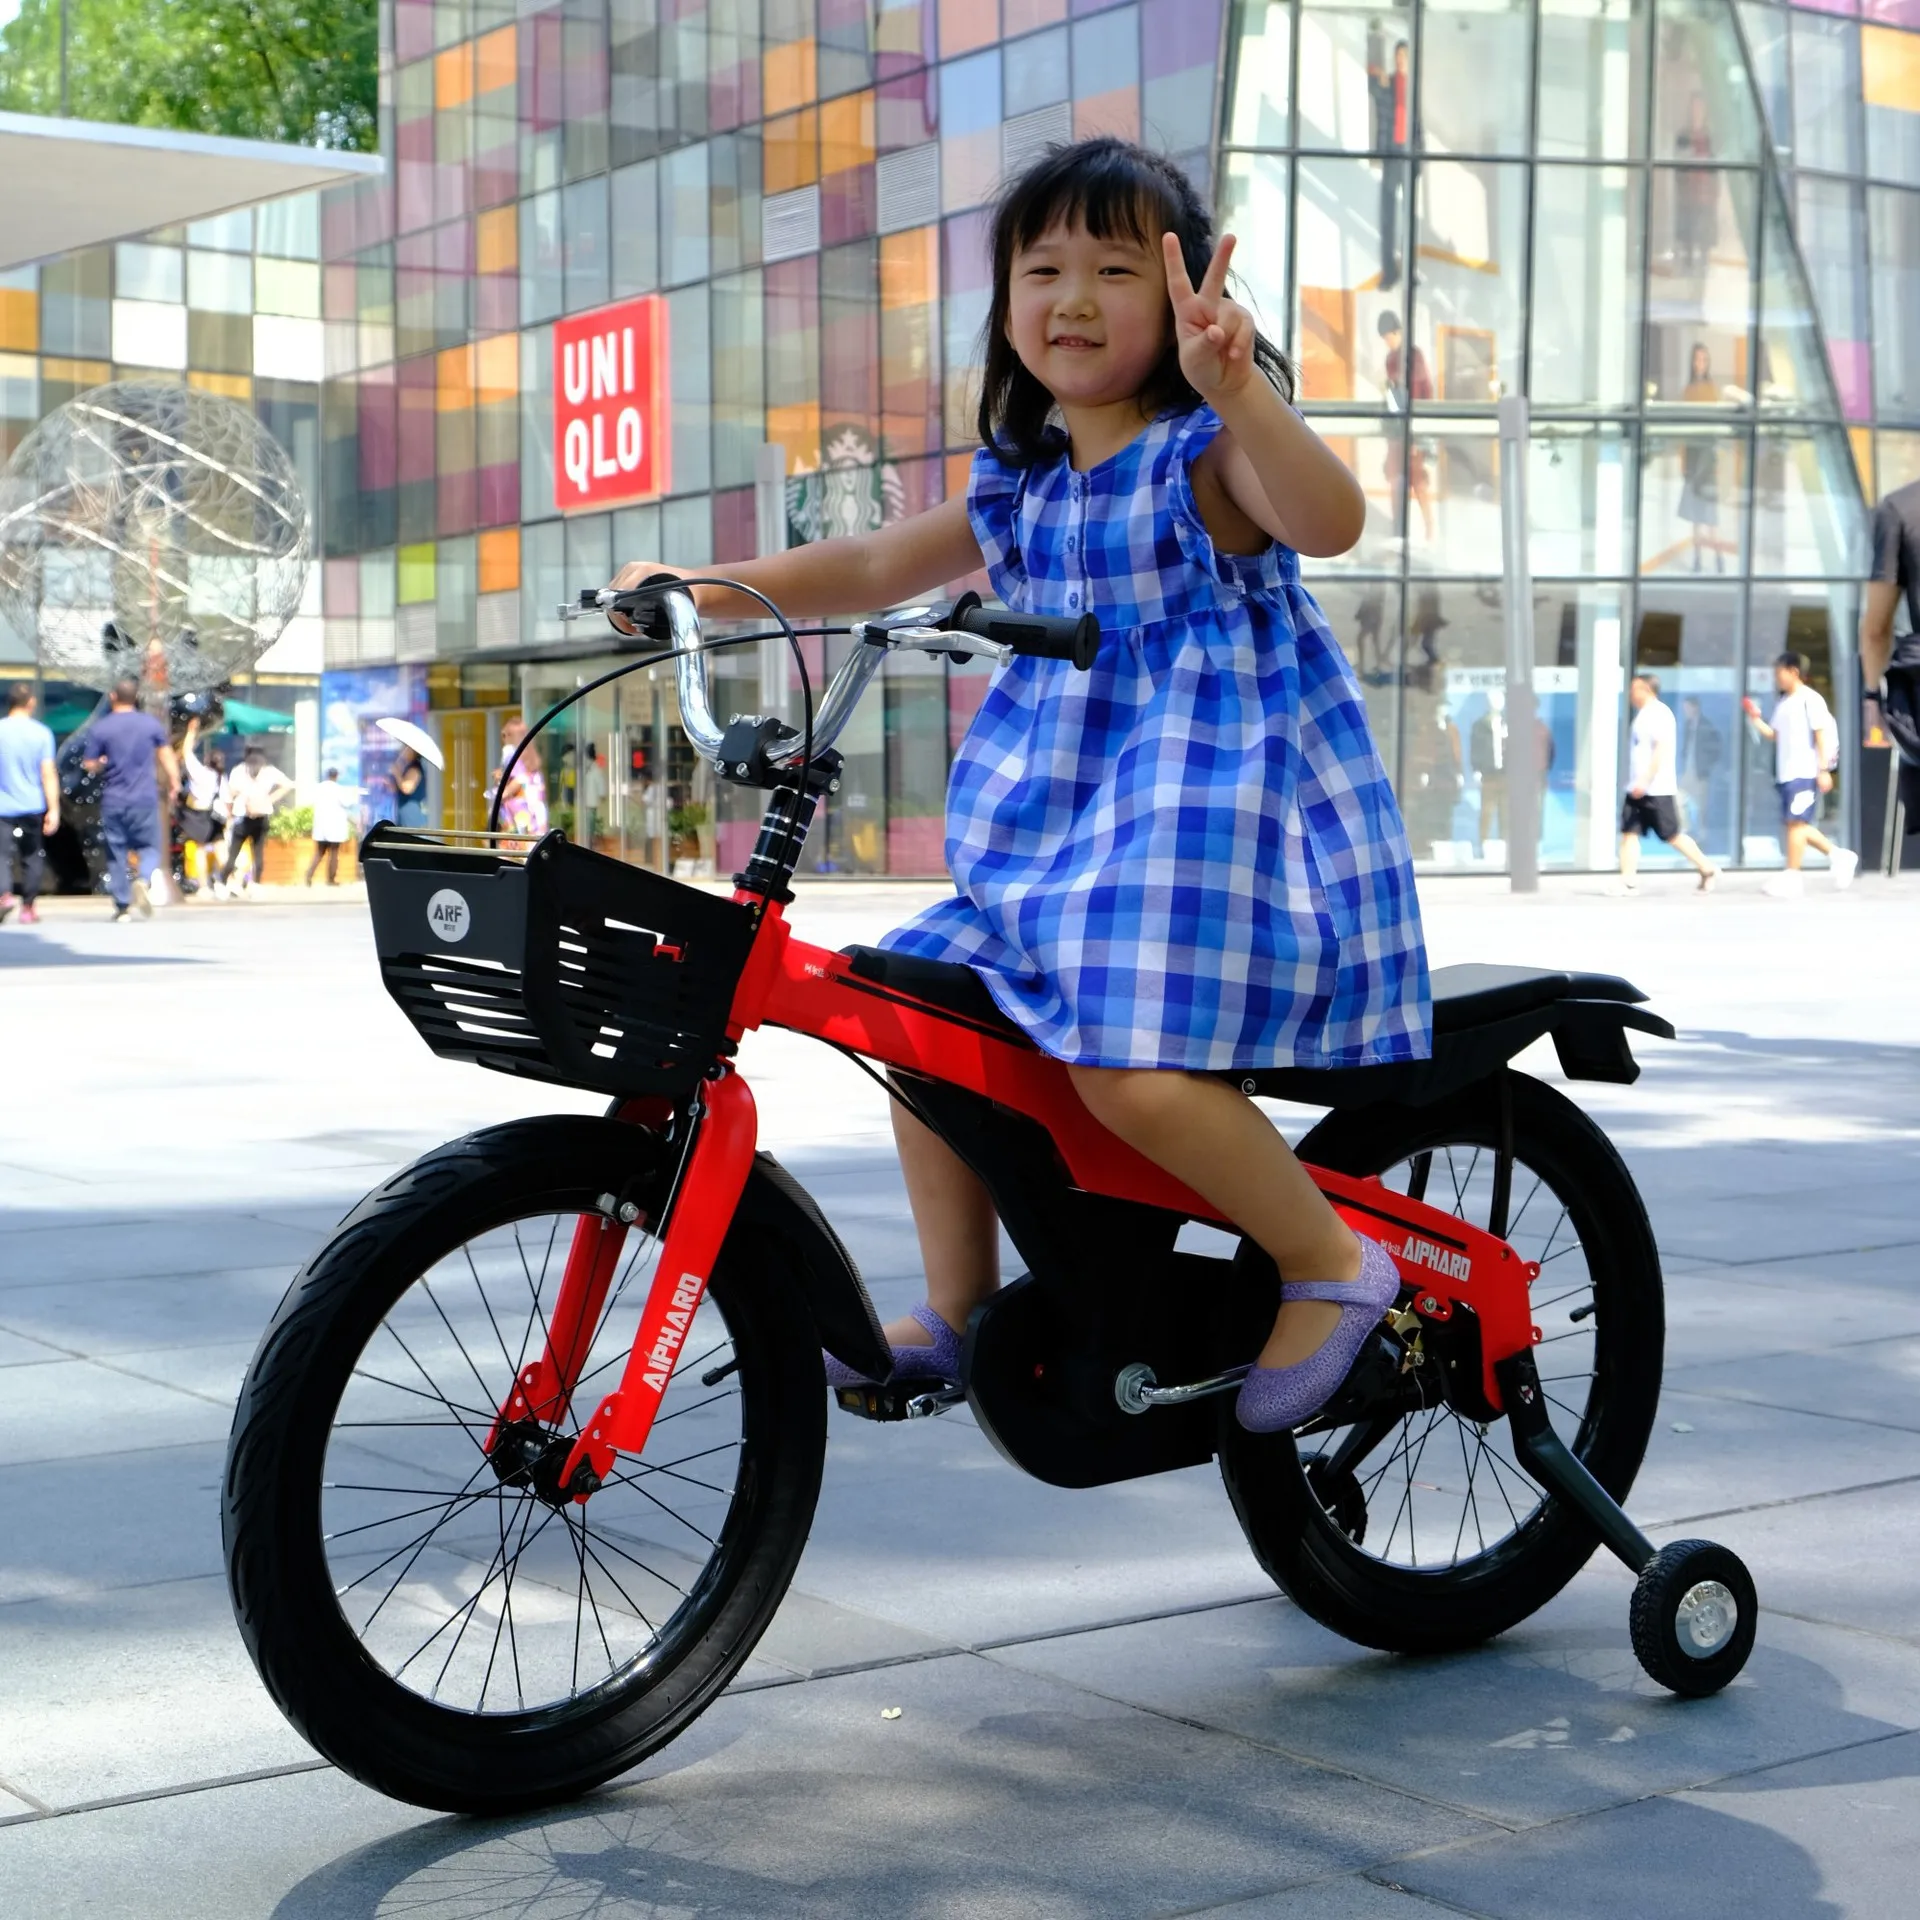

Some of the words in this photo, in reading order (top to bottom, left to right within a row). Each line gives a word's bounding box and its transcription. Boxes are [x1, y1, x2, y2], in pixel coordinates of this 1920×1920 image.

[564, 327, 635, 405] UNI
[564, 406, 642, 493] QLO
[433, 903, 463, 922] ARF
